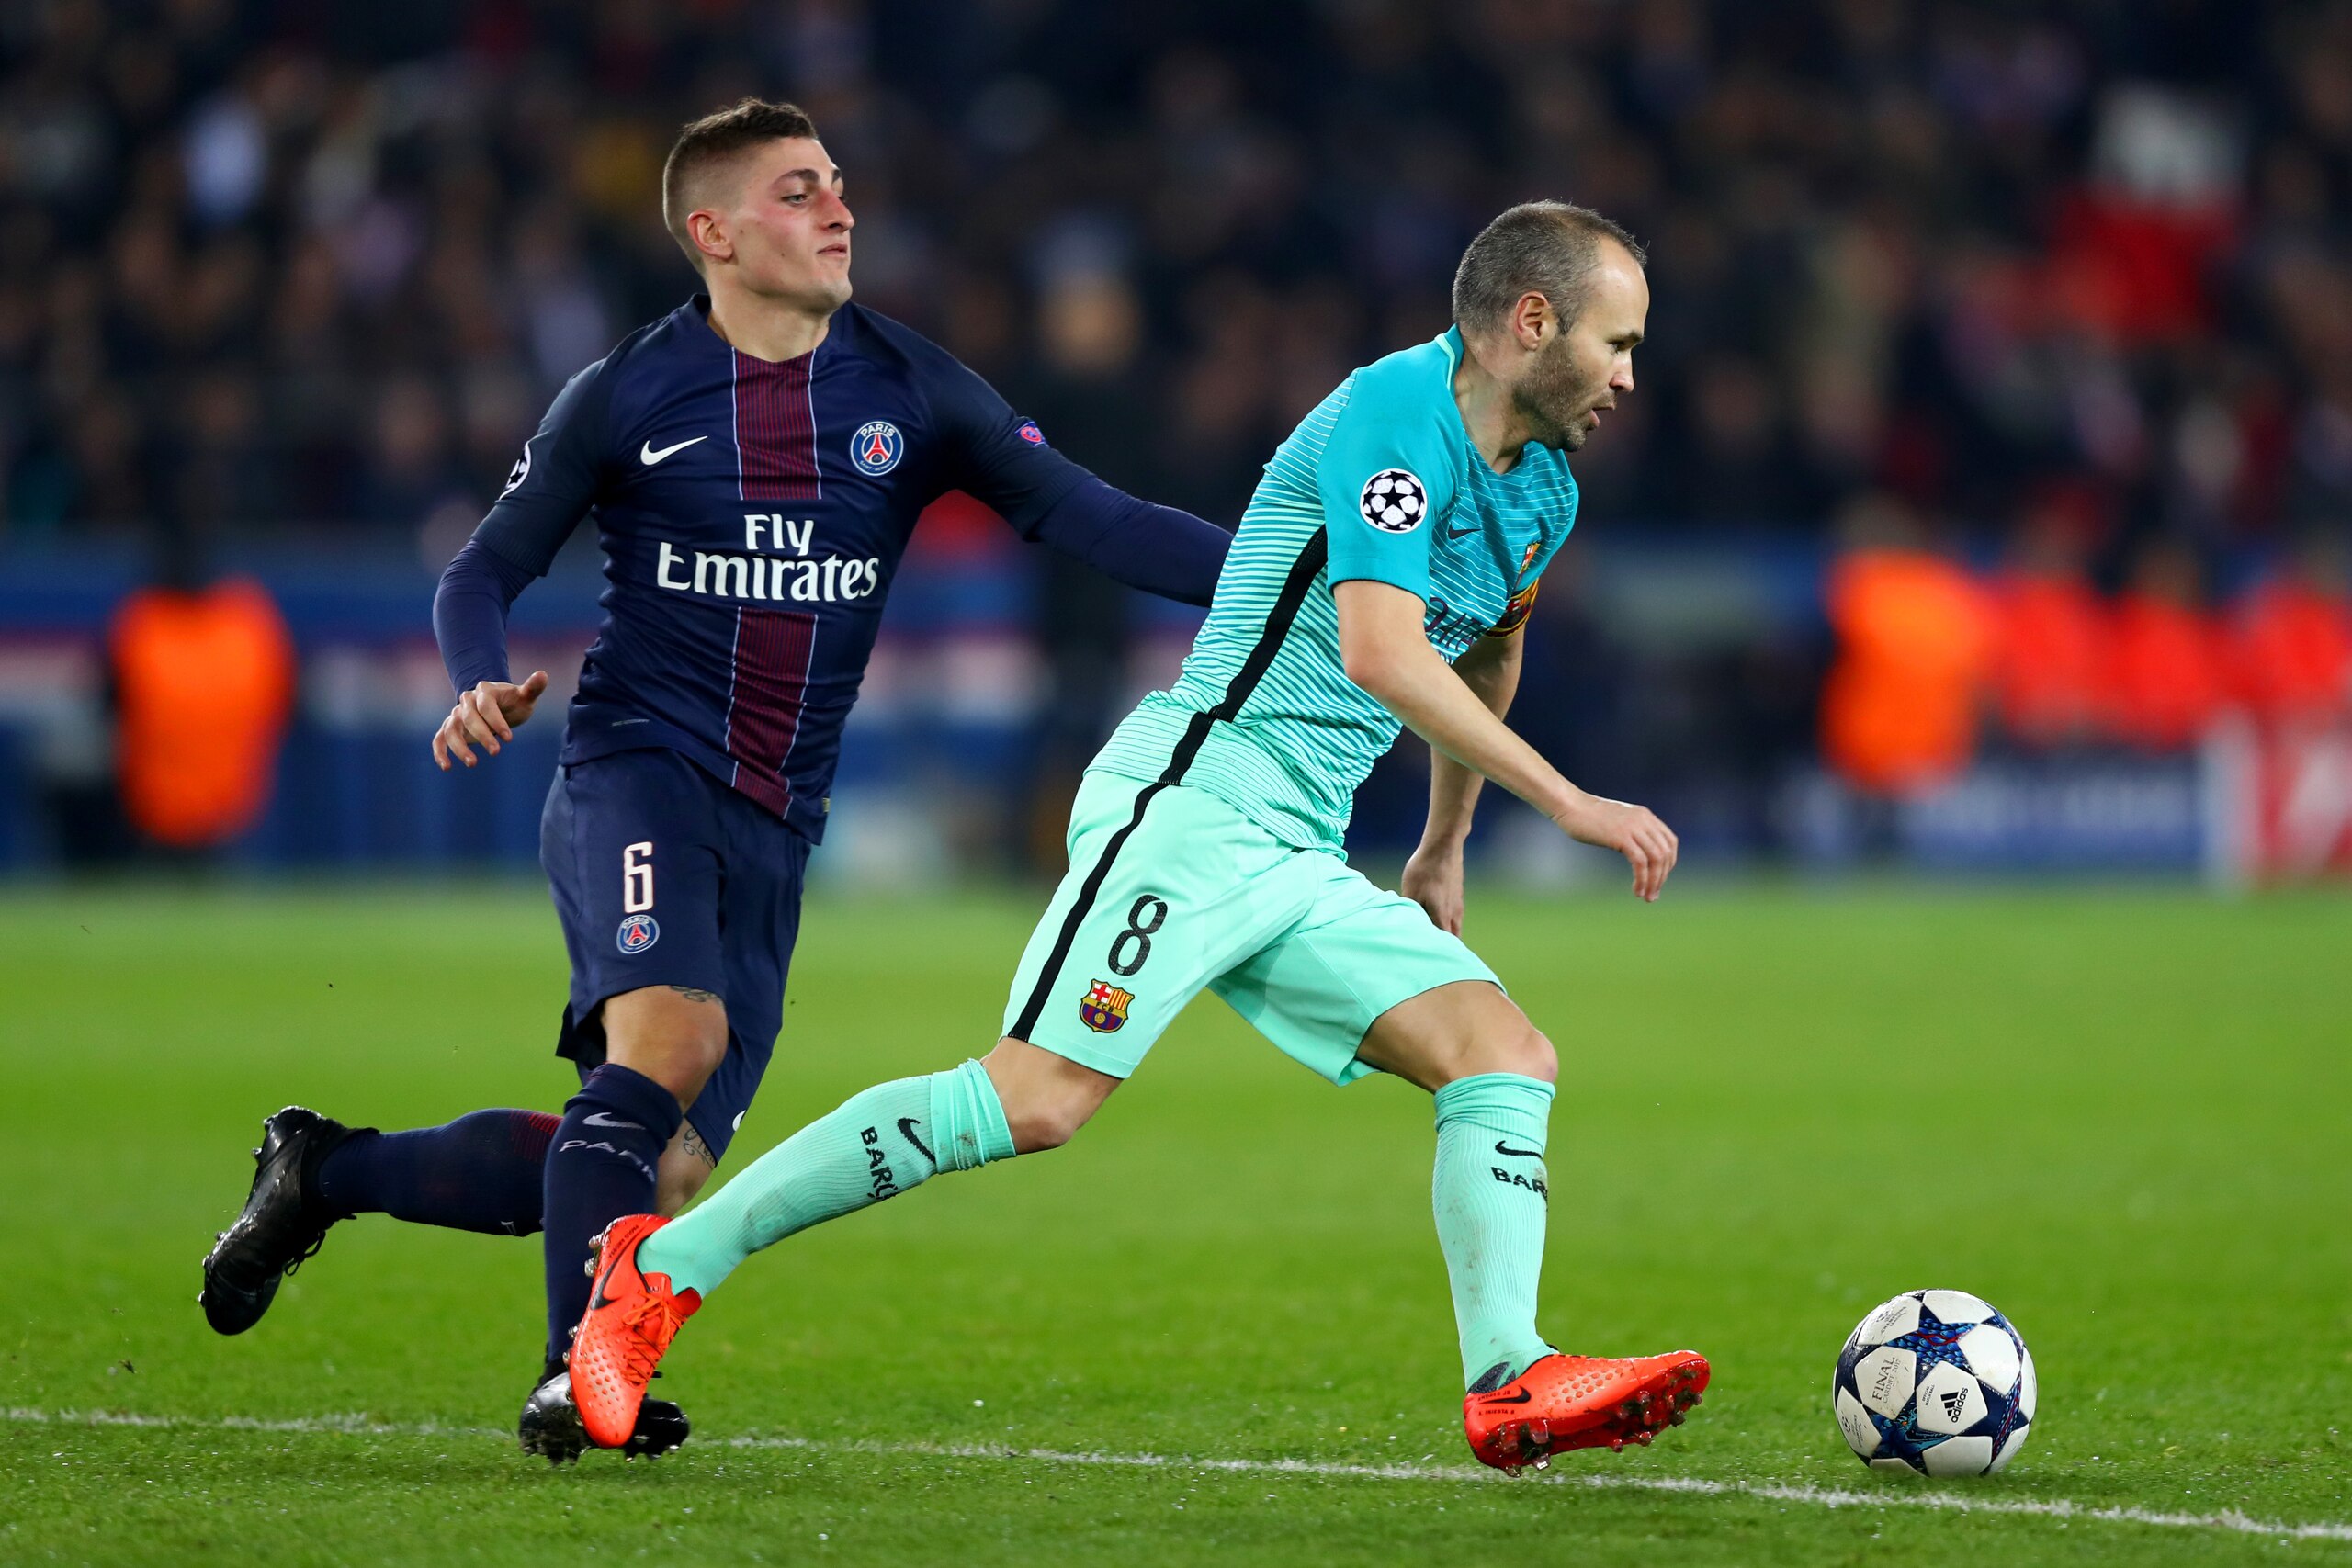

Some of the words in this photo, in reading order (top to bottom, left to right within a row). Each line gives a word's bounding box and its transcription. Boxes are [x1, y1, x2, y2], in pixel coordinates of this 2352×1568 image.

[860, 423, 896, 437] PARIS
[743, 513, 815, 557] Fly
[657, 541, 879, 602] Emirates
[624, 841, 653, 914] 6
[1108, 894, 1168, 976] 8
[1871, 1357, 1895, 1401] FINAL
[1951, 1387, 1968, 1423] adidas
